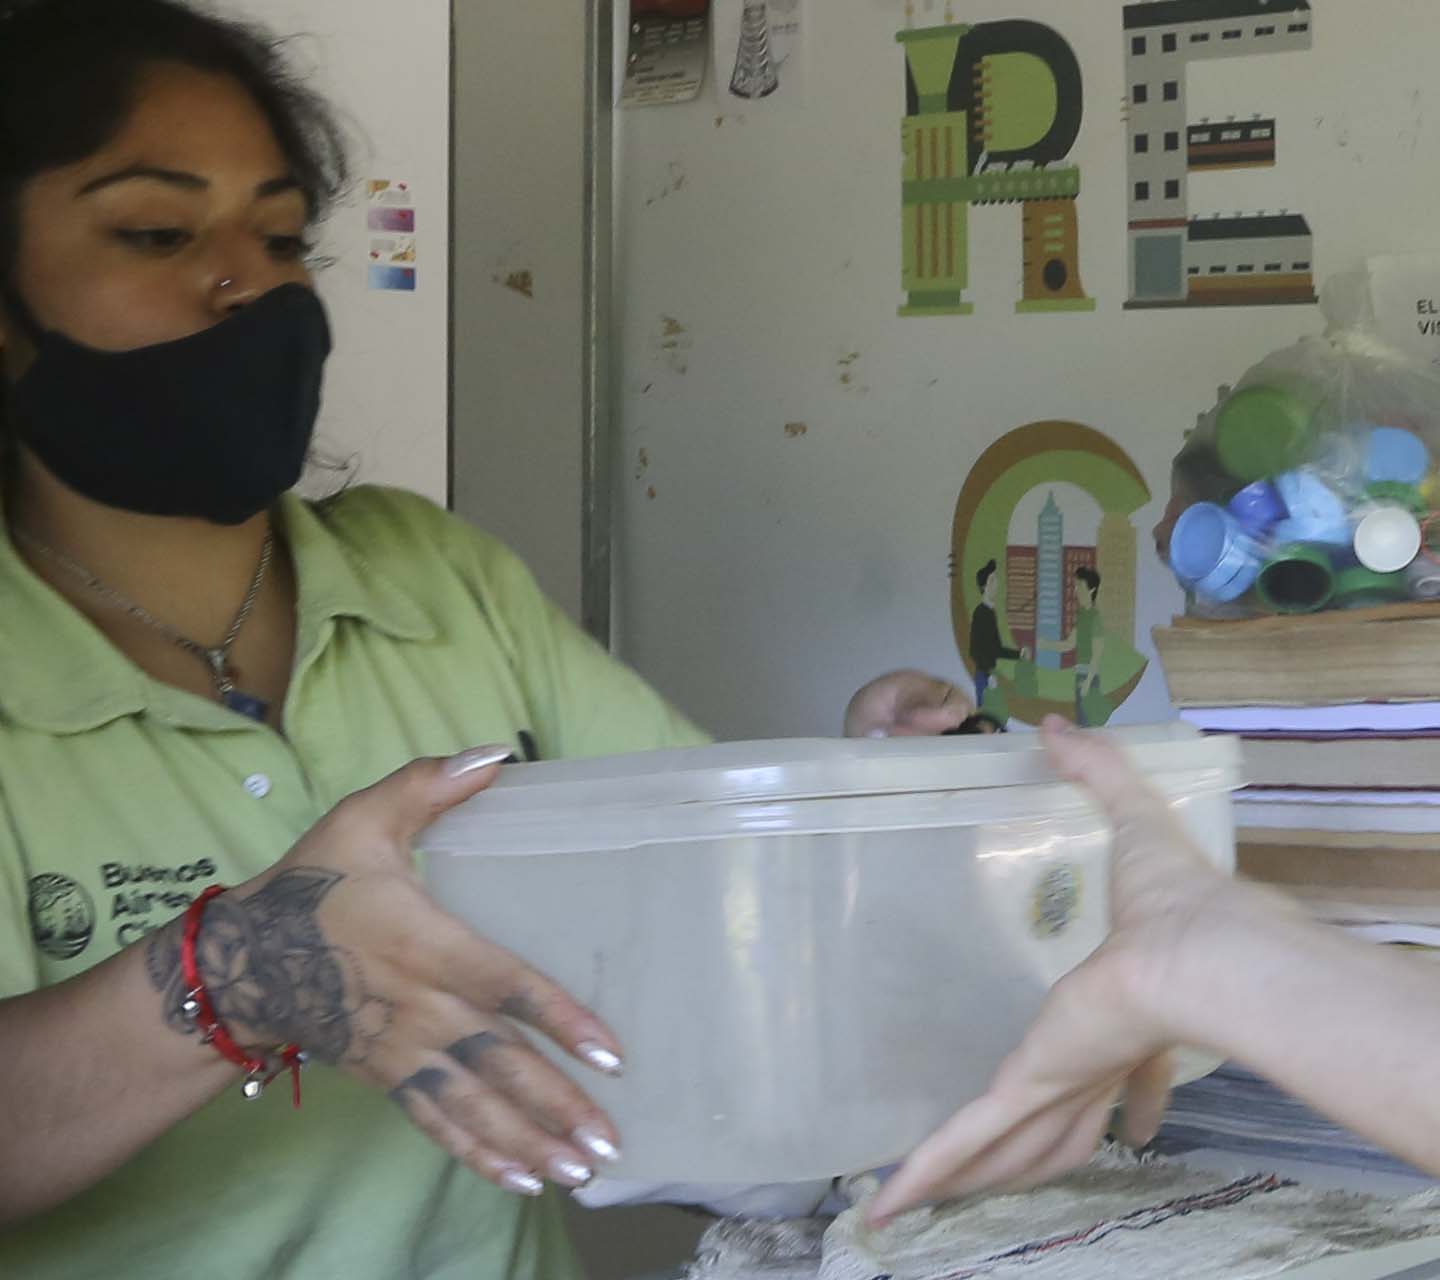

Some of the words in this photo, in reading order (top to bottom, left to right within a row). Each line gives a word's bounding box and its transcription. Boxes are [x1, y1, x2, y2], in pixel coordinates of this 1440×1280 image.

[1416, 298, 1438, 315] EL
[102, 858, 217, 889] Buenos
[113, 888, 193, 920] Aires
